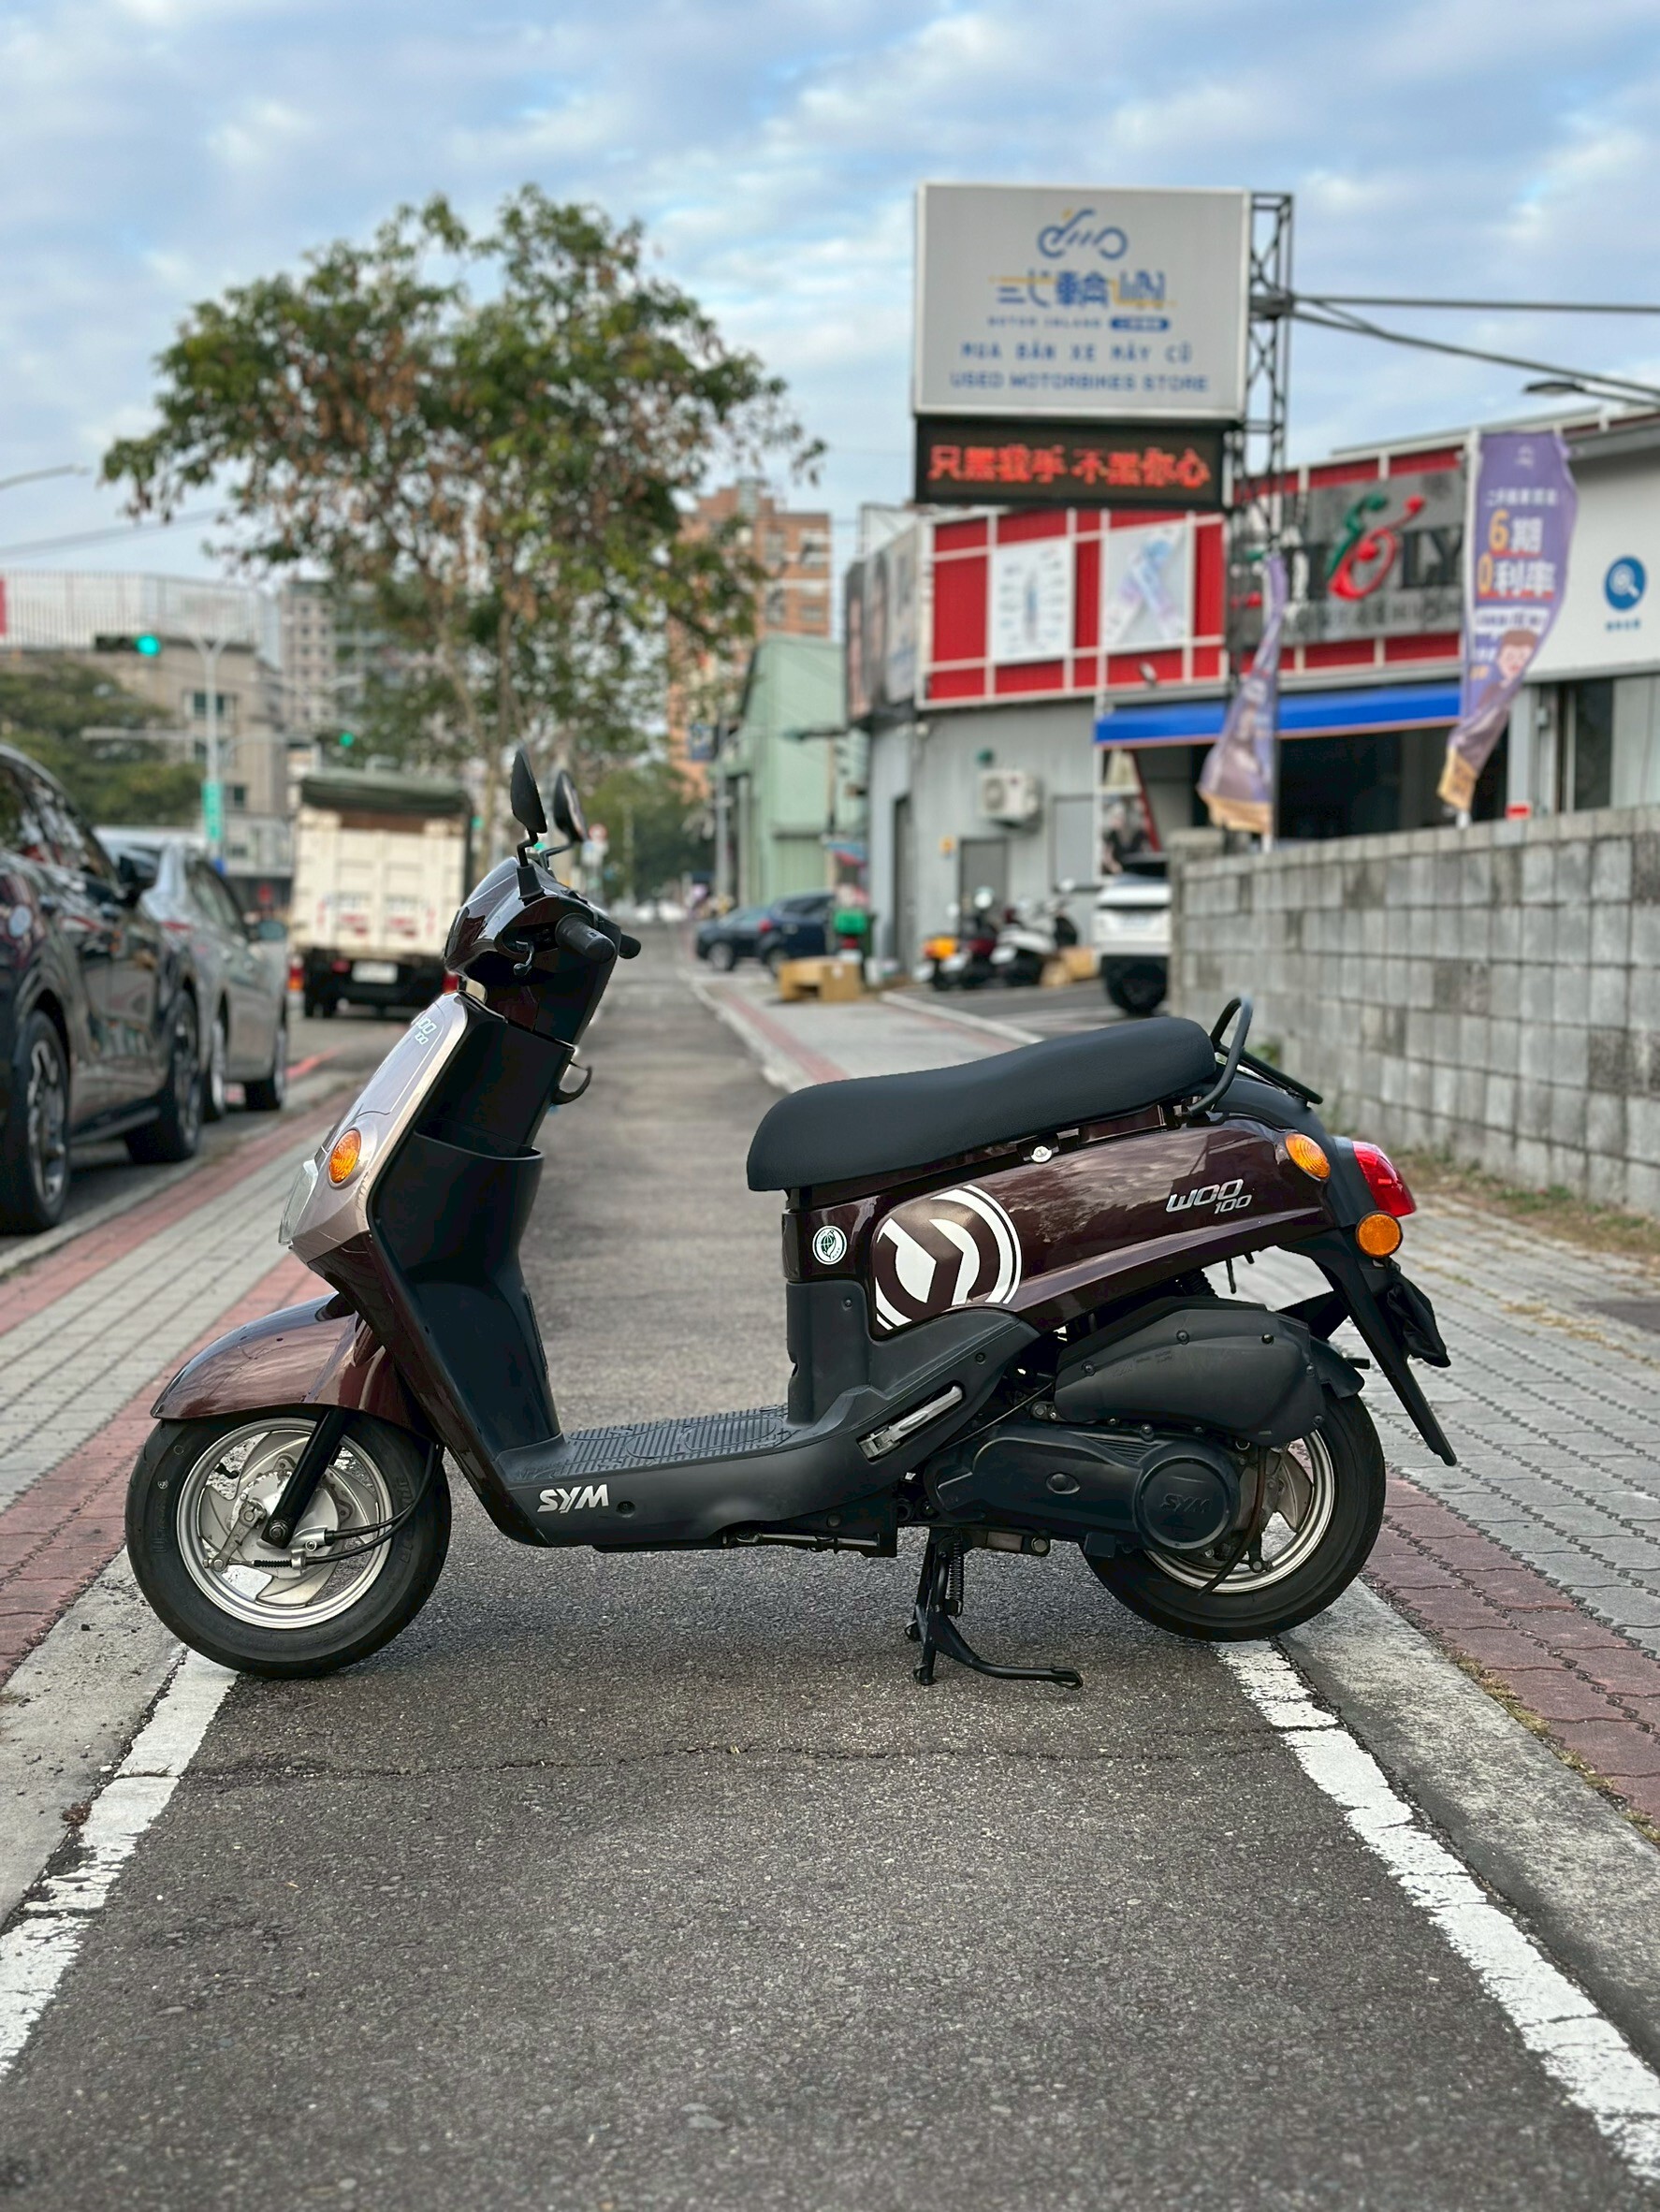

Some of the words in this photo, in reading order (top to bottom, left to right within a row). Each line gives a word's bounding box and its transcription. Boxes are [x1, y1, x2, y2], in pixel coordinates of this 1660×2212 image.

[950, 371, 1004, 388] USED
[1010, 372, 1136, 390] MOTORBIKES
[1143, 373, 1209, 391] STORE
[1165, 1178, 1244, 1213] WOO
[1214, 1194, 1252, 1215] 100
[536, 1483, 609, 1514] SYM
[1159, 1492, 1213, 1514] SYM
